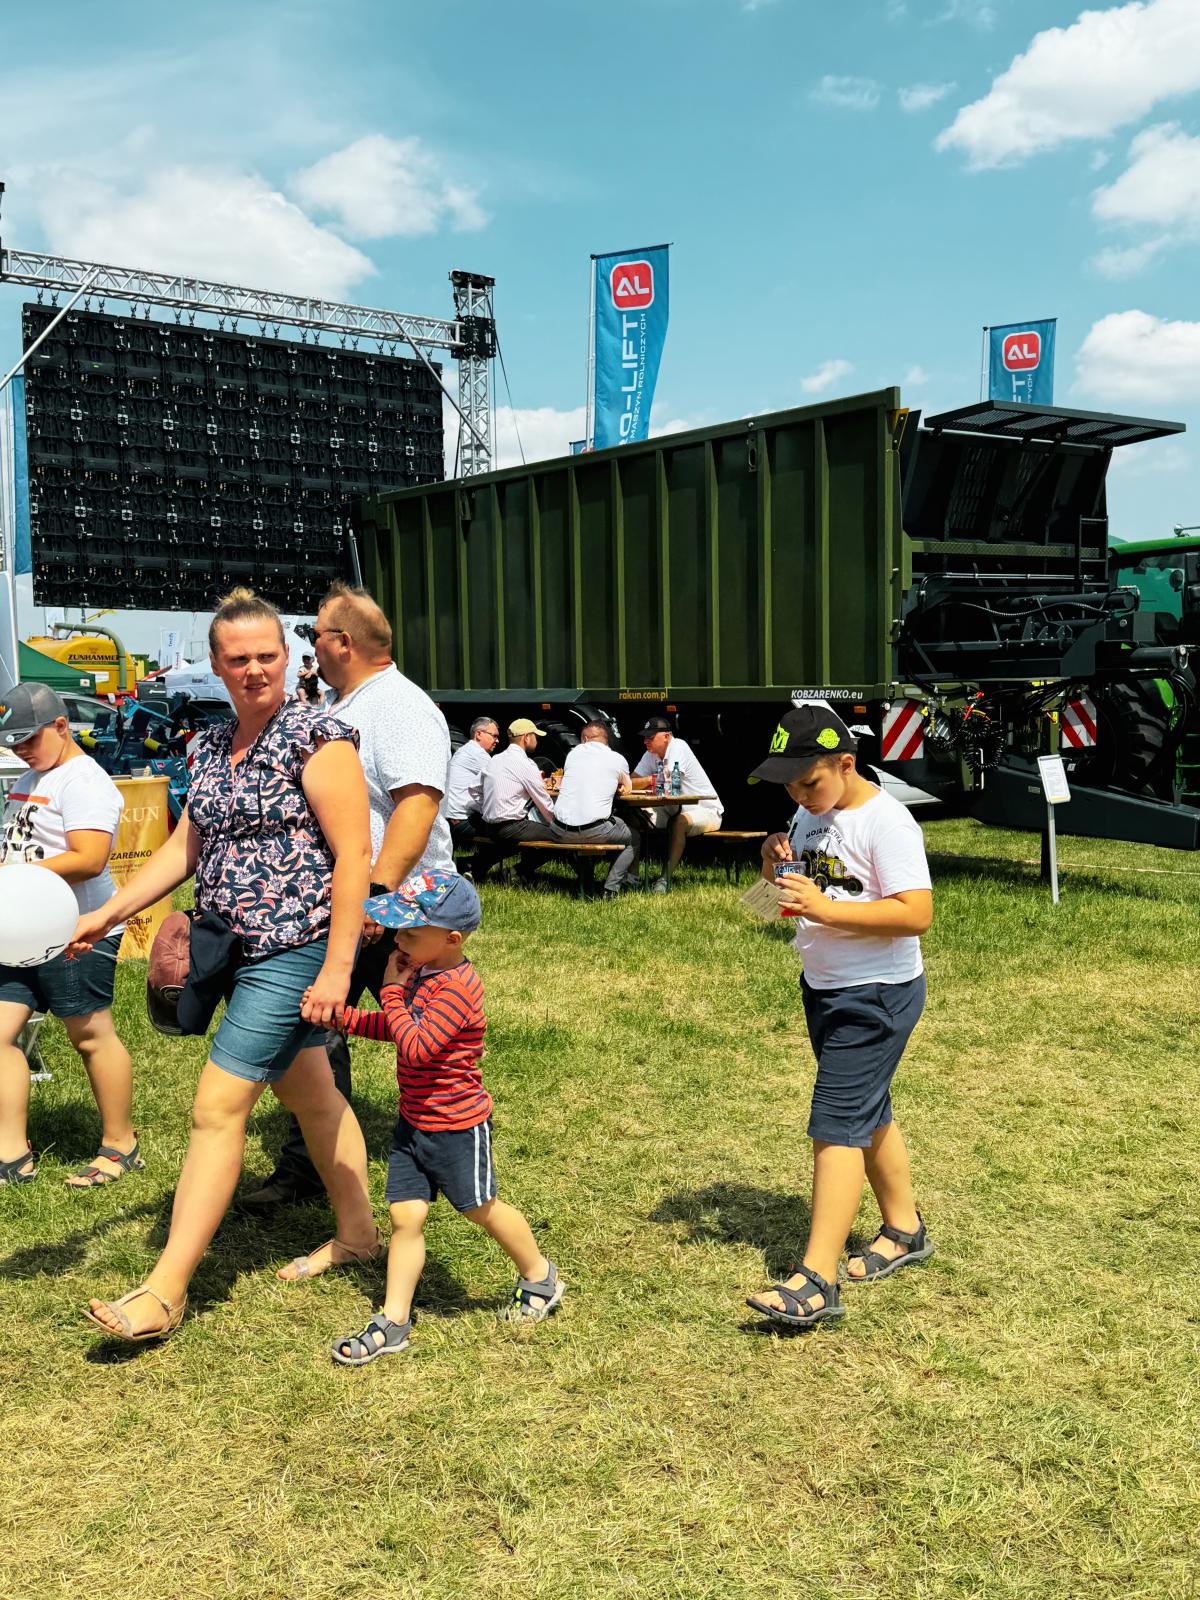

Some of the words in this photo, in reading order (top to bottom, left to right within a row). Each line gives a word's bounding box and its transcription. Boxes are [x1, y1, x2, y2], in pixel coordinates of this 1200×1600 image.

[616, 276, 650, 297] AL
[1007, 343, 1037, 360] AL
[630, 391, 642, 439] MASZYN
[619, 688, 669, 702] rakun.com.pl
[791, 689, 863, 699] KOBZARENKO.eu
[120, 806, 160, 824] KUN
[110, 849, 153, 861] ZARENKO
